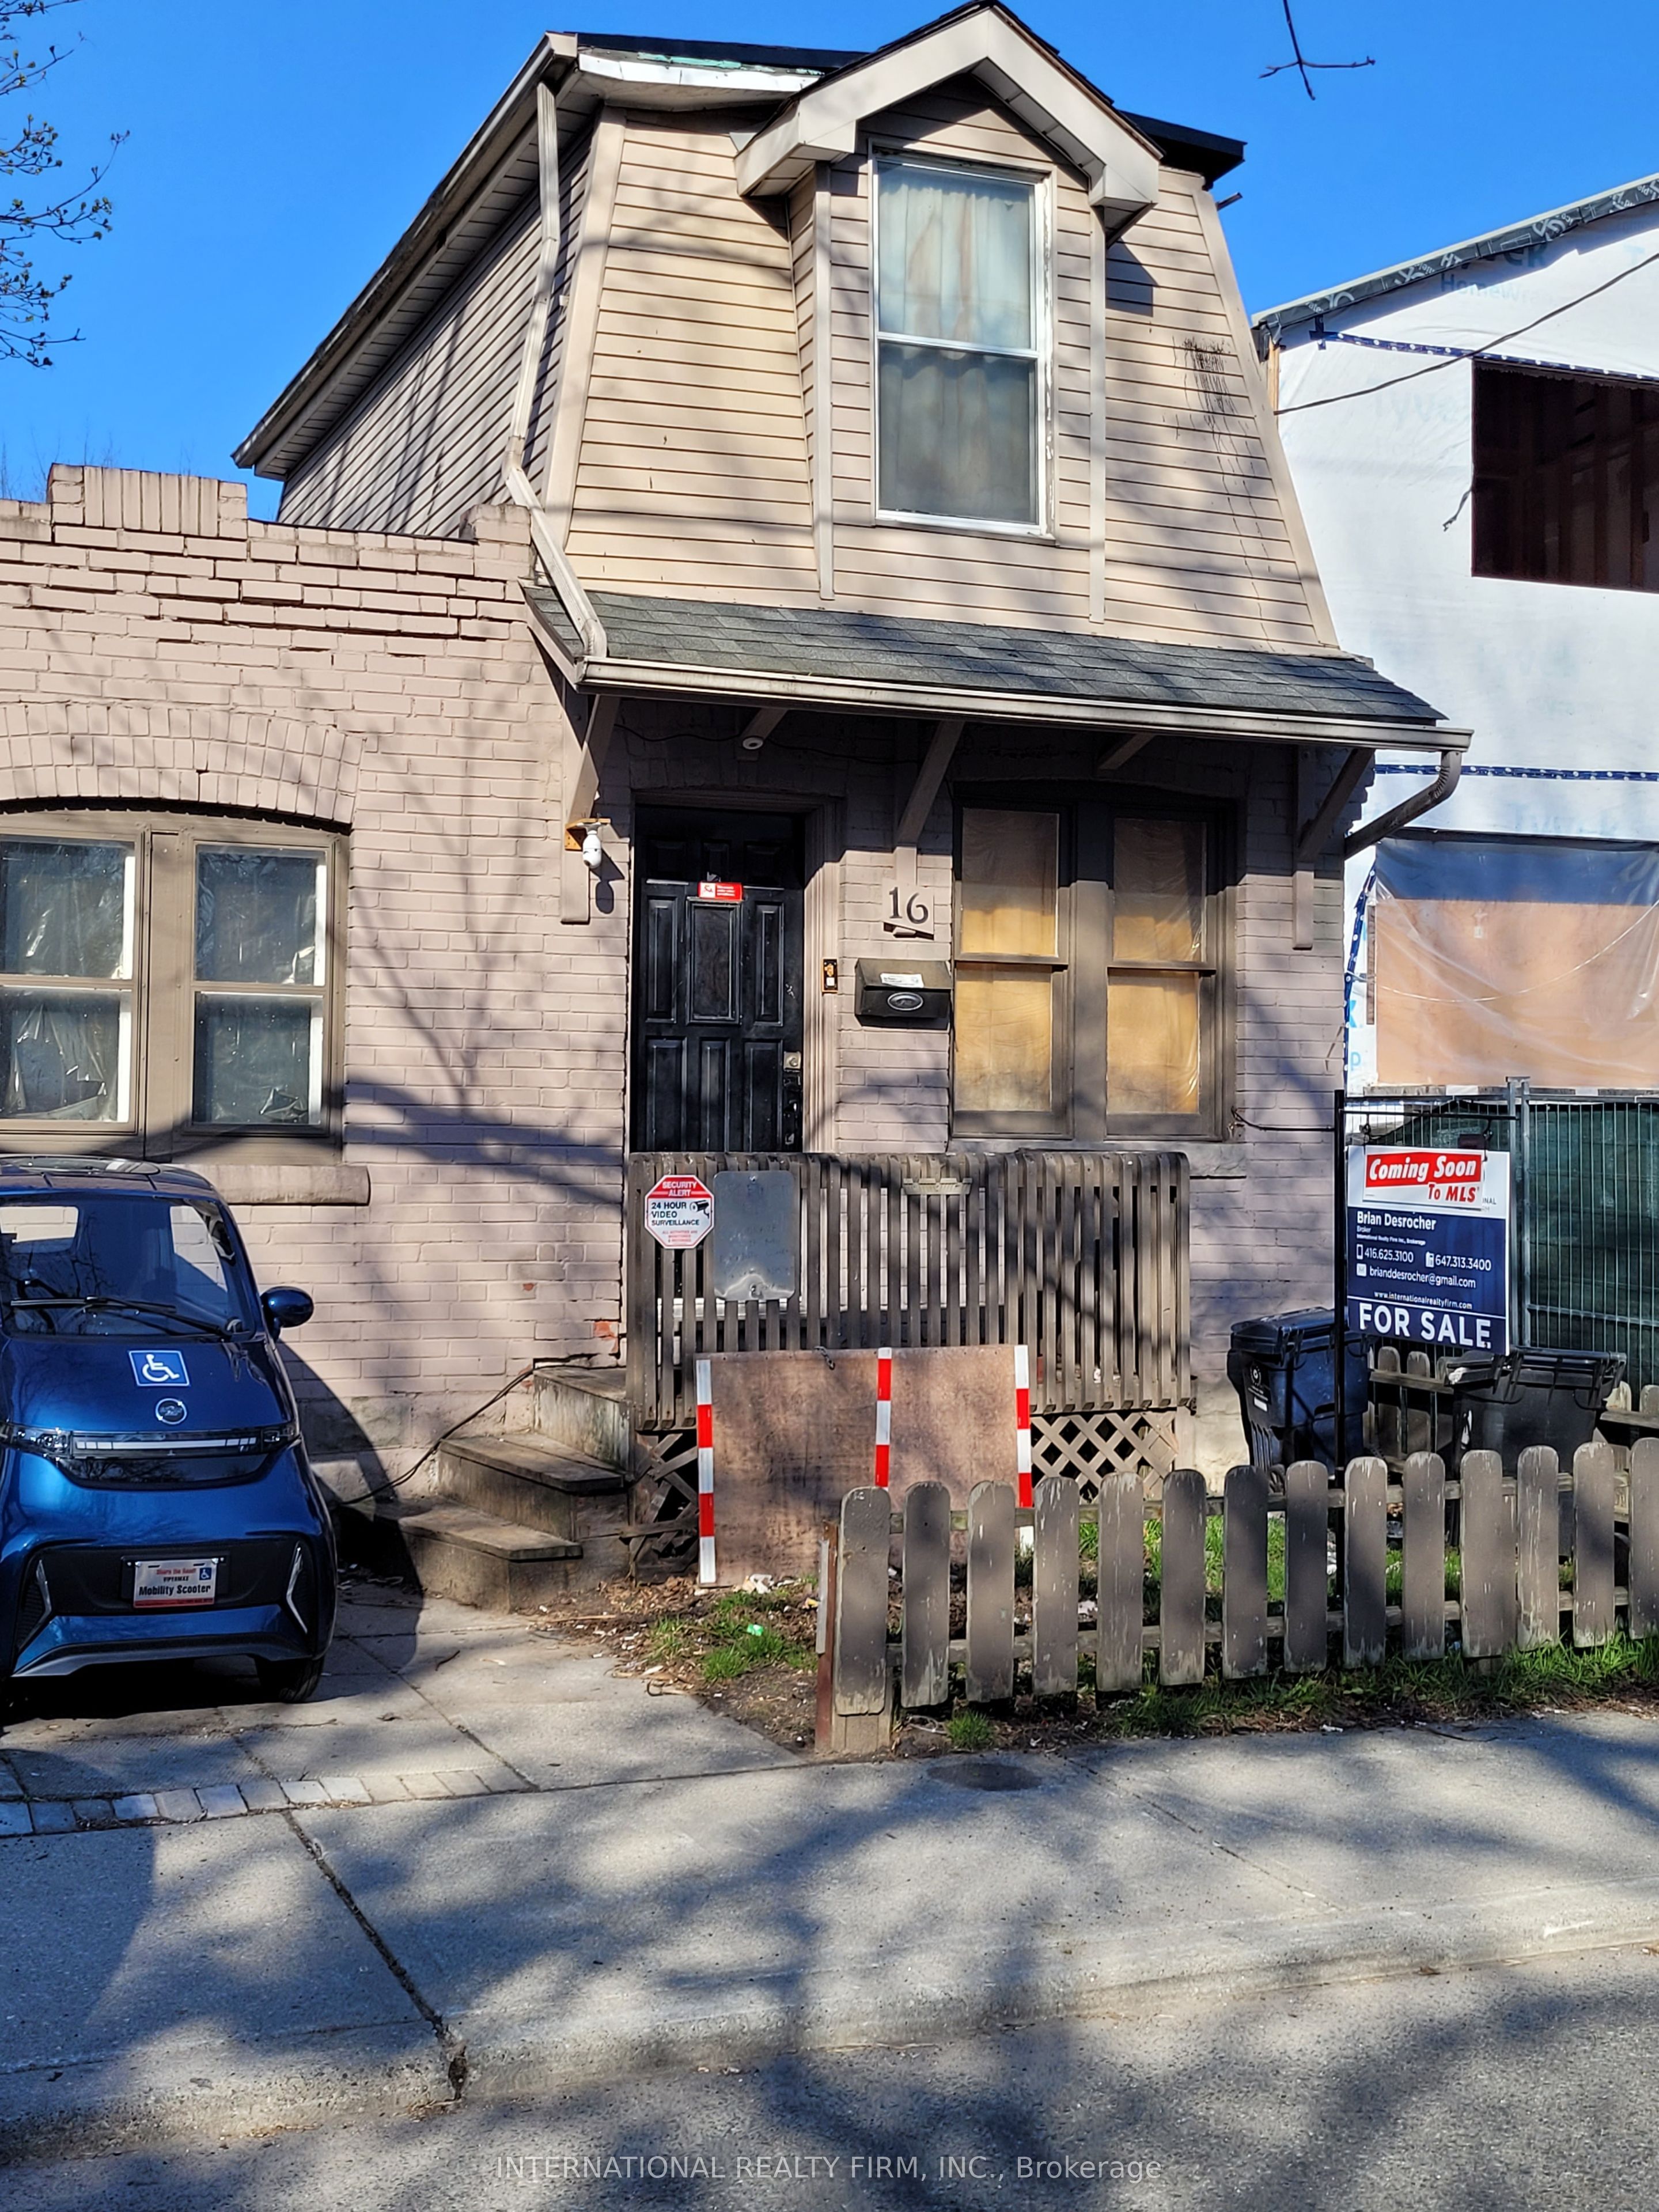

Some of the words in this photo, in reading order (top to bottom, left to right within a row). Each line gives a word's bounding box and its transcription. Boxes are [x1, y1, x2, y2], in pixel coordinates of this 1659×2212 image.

[889, 887, 929, 925] 16
[1369, 1157, 1429, 1181] Coming
[1434, 1154, 1476, 1179] Soon
[1428, 1184, 1440, 1200] To
[1445, 1187, 1476, 1202] MLS
[1357, 1211, 1381, 1225] Brian
[1384, 1213, 1437, 1230] Desrocher
[1365, 1248, 1414, 1263] 416.625.3100
[1435, 1255, 1491, 1271] 647.313.3400
[1369, 1266, 1476, 1289] brianddesrocher@gmail.com
[1374, 1291, 1472, 1309] www.internationalrealtyfirm.com
[1359, 1302, 1410, 1337] FOR
[1421, 1311, 1491, 1349] SALE
[139, 1586, 174, 1596] Mobility
[177, 1585, 211, 1594] Scooter
